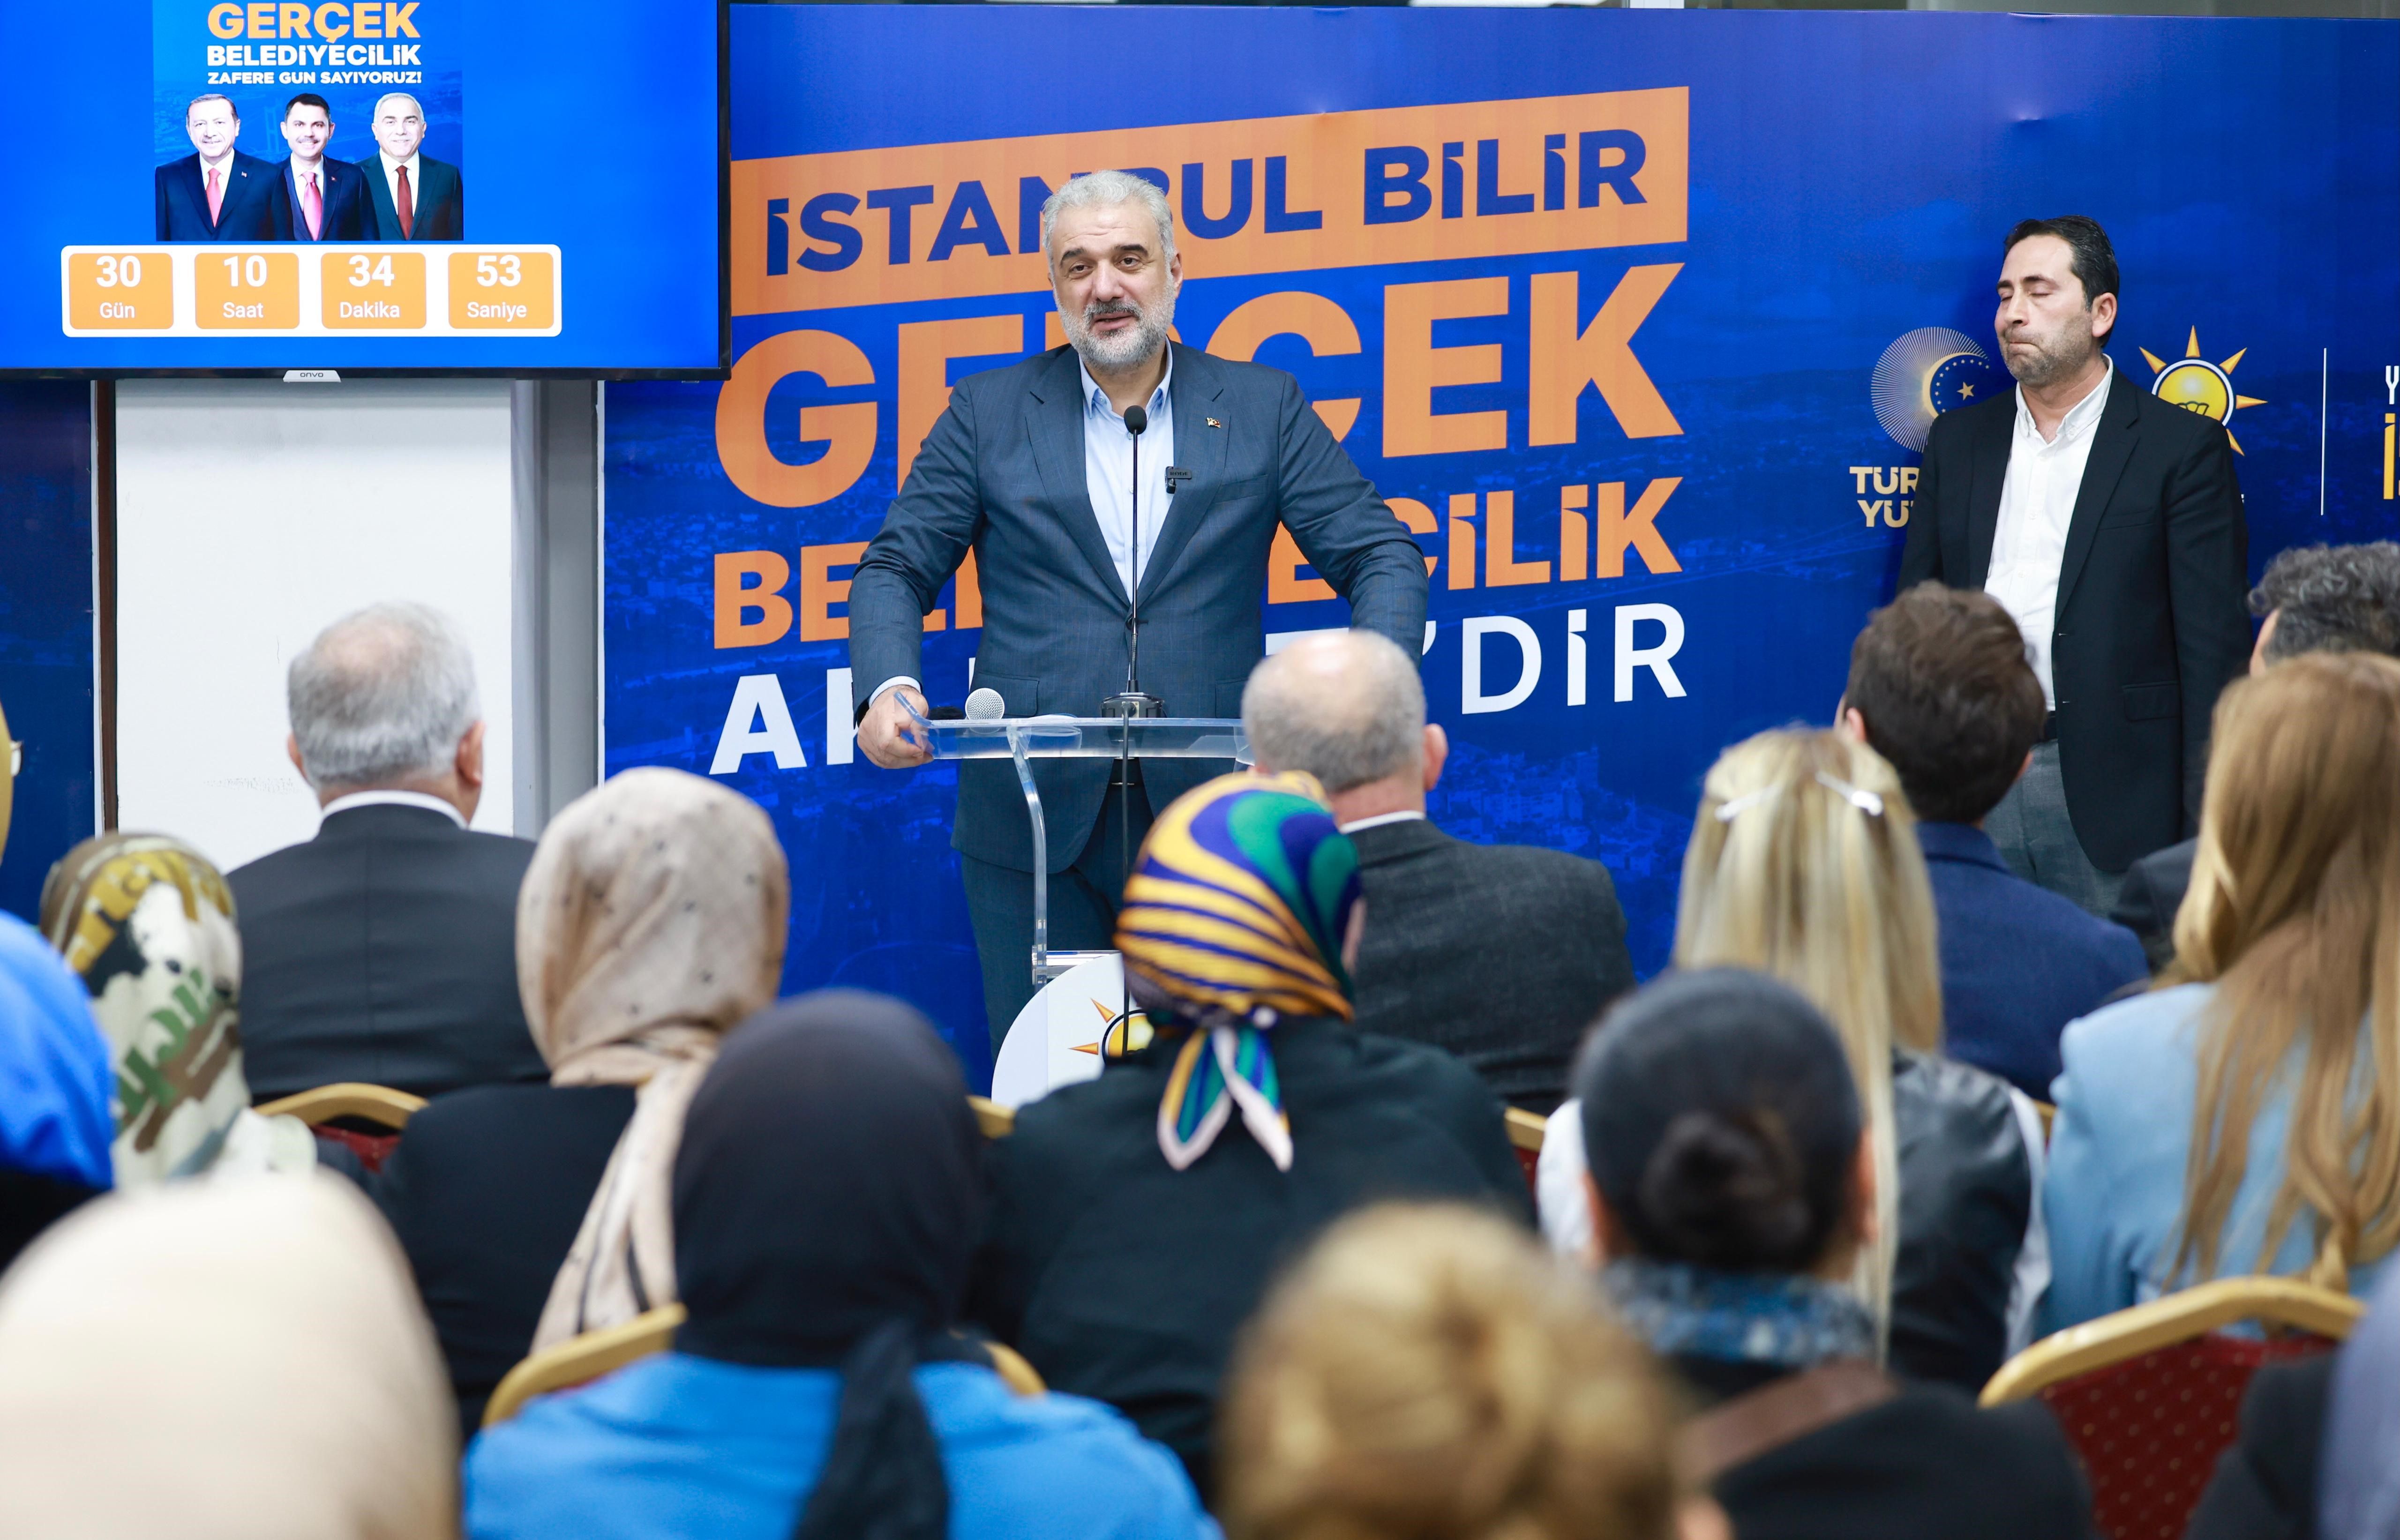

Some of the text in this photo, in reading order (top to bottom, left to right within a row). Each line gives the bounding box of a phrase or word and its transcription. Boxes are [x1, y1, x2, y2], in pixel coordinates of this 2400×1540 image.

[208, 2, 421, 44] GERÇEK
[208, 72, 274, 84] ZAFERE
[320, 71, 421, 84] SAYIYORUZ!
[1364, 128, 1648, 225] BİLİR
[96, 255, 141, 288] 30
[223, 255, 268, 287] 10
[348, 254, 395, 287] 34
[476, 254, 521, 287] 53
[99, 302, 135, 319] Gün
[223, 302, 264, 318] Saat
[339, 301, 400, 318] Dakika
[467, 301, 527, 322] Saniye
[715, 262, 1685, 508] GEEK
